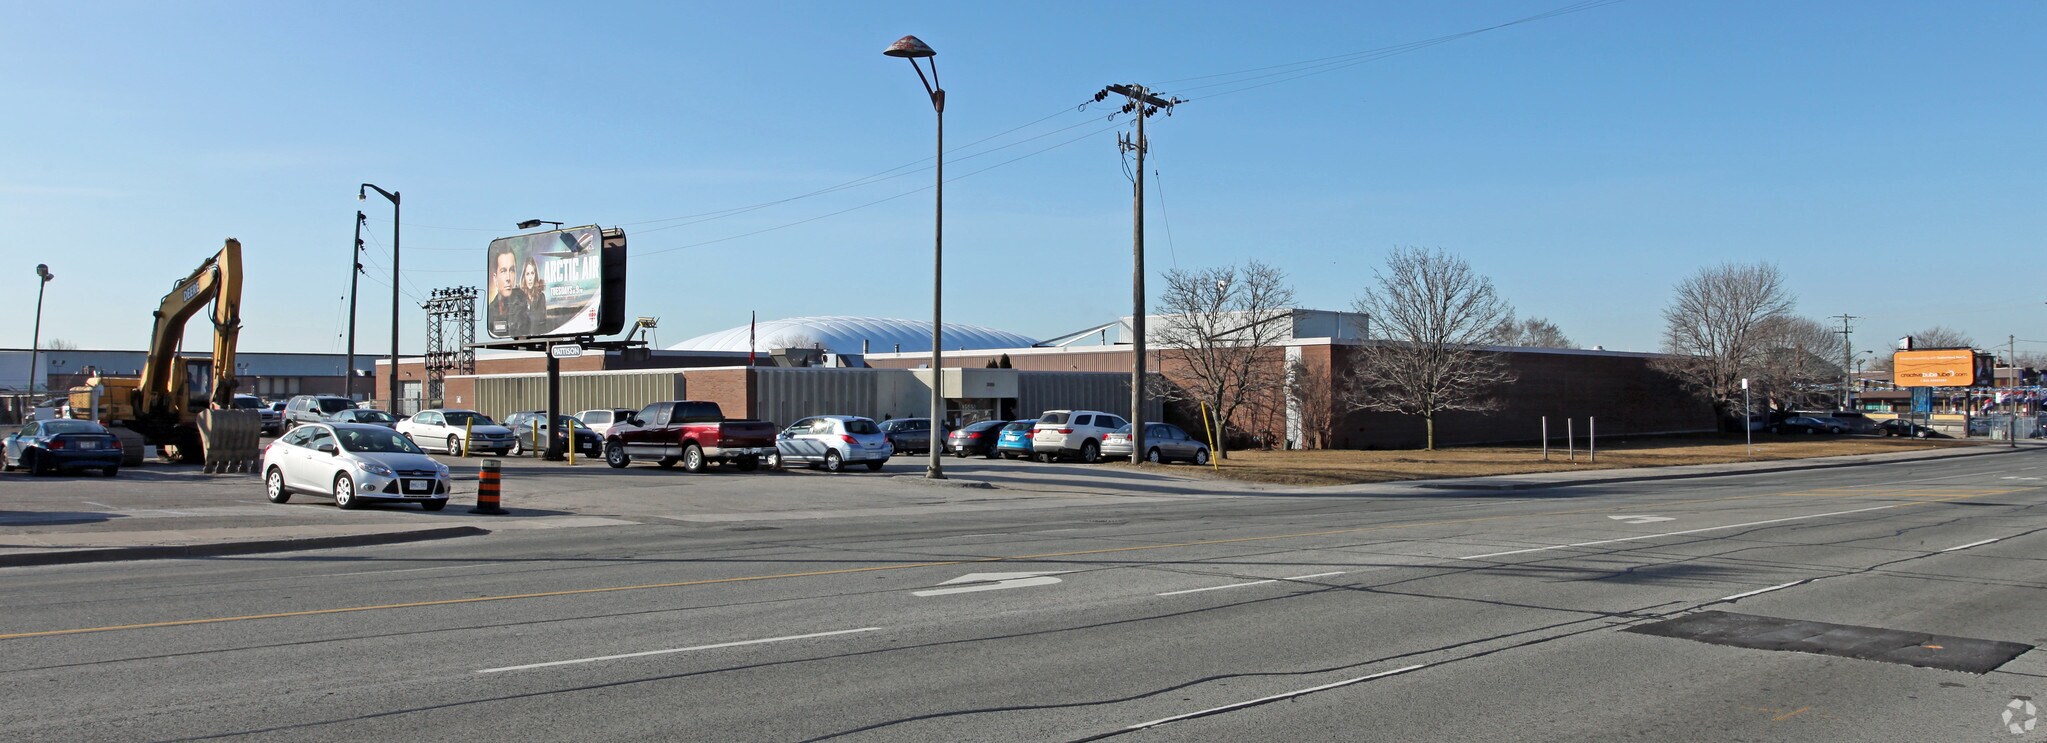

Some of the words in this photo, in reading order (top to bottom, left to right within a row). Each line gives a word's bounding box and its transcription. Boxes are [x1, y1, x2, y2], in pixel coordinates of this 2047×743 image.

[544, 257, 579, 283] ARCTIC
[582, 255, 599, 280] AIR
[183, 281, 200, 302] DEERE
[553, 347, 580, 355] PATTISON
